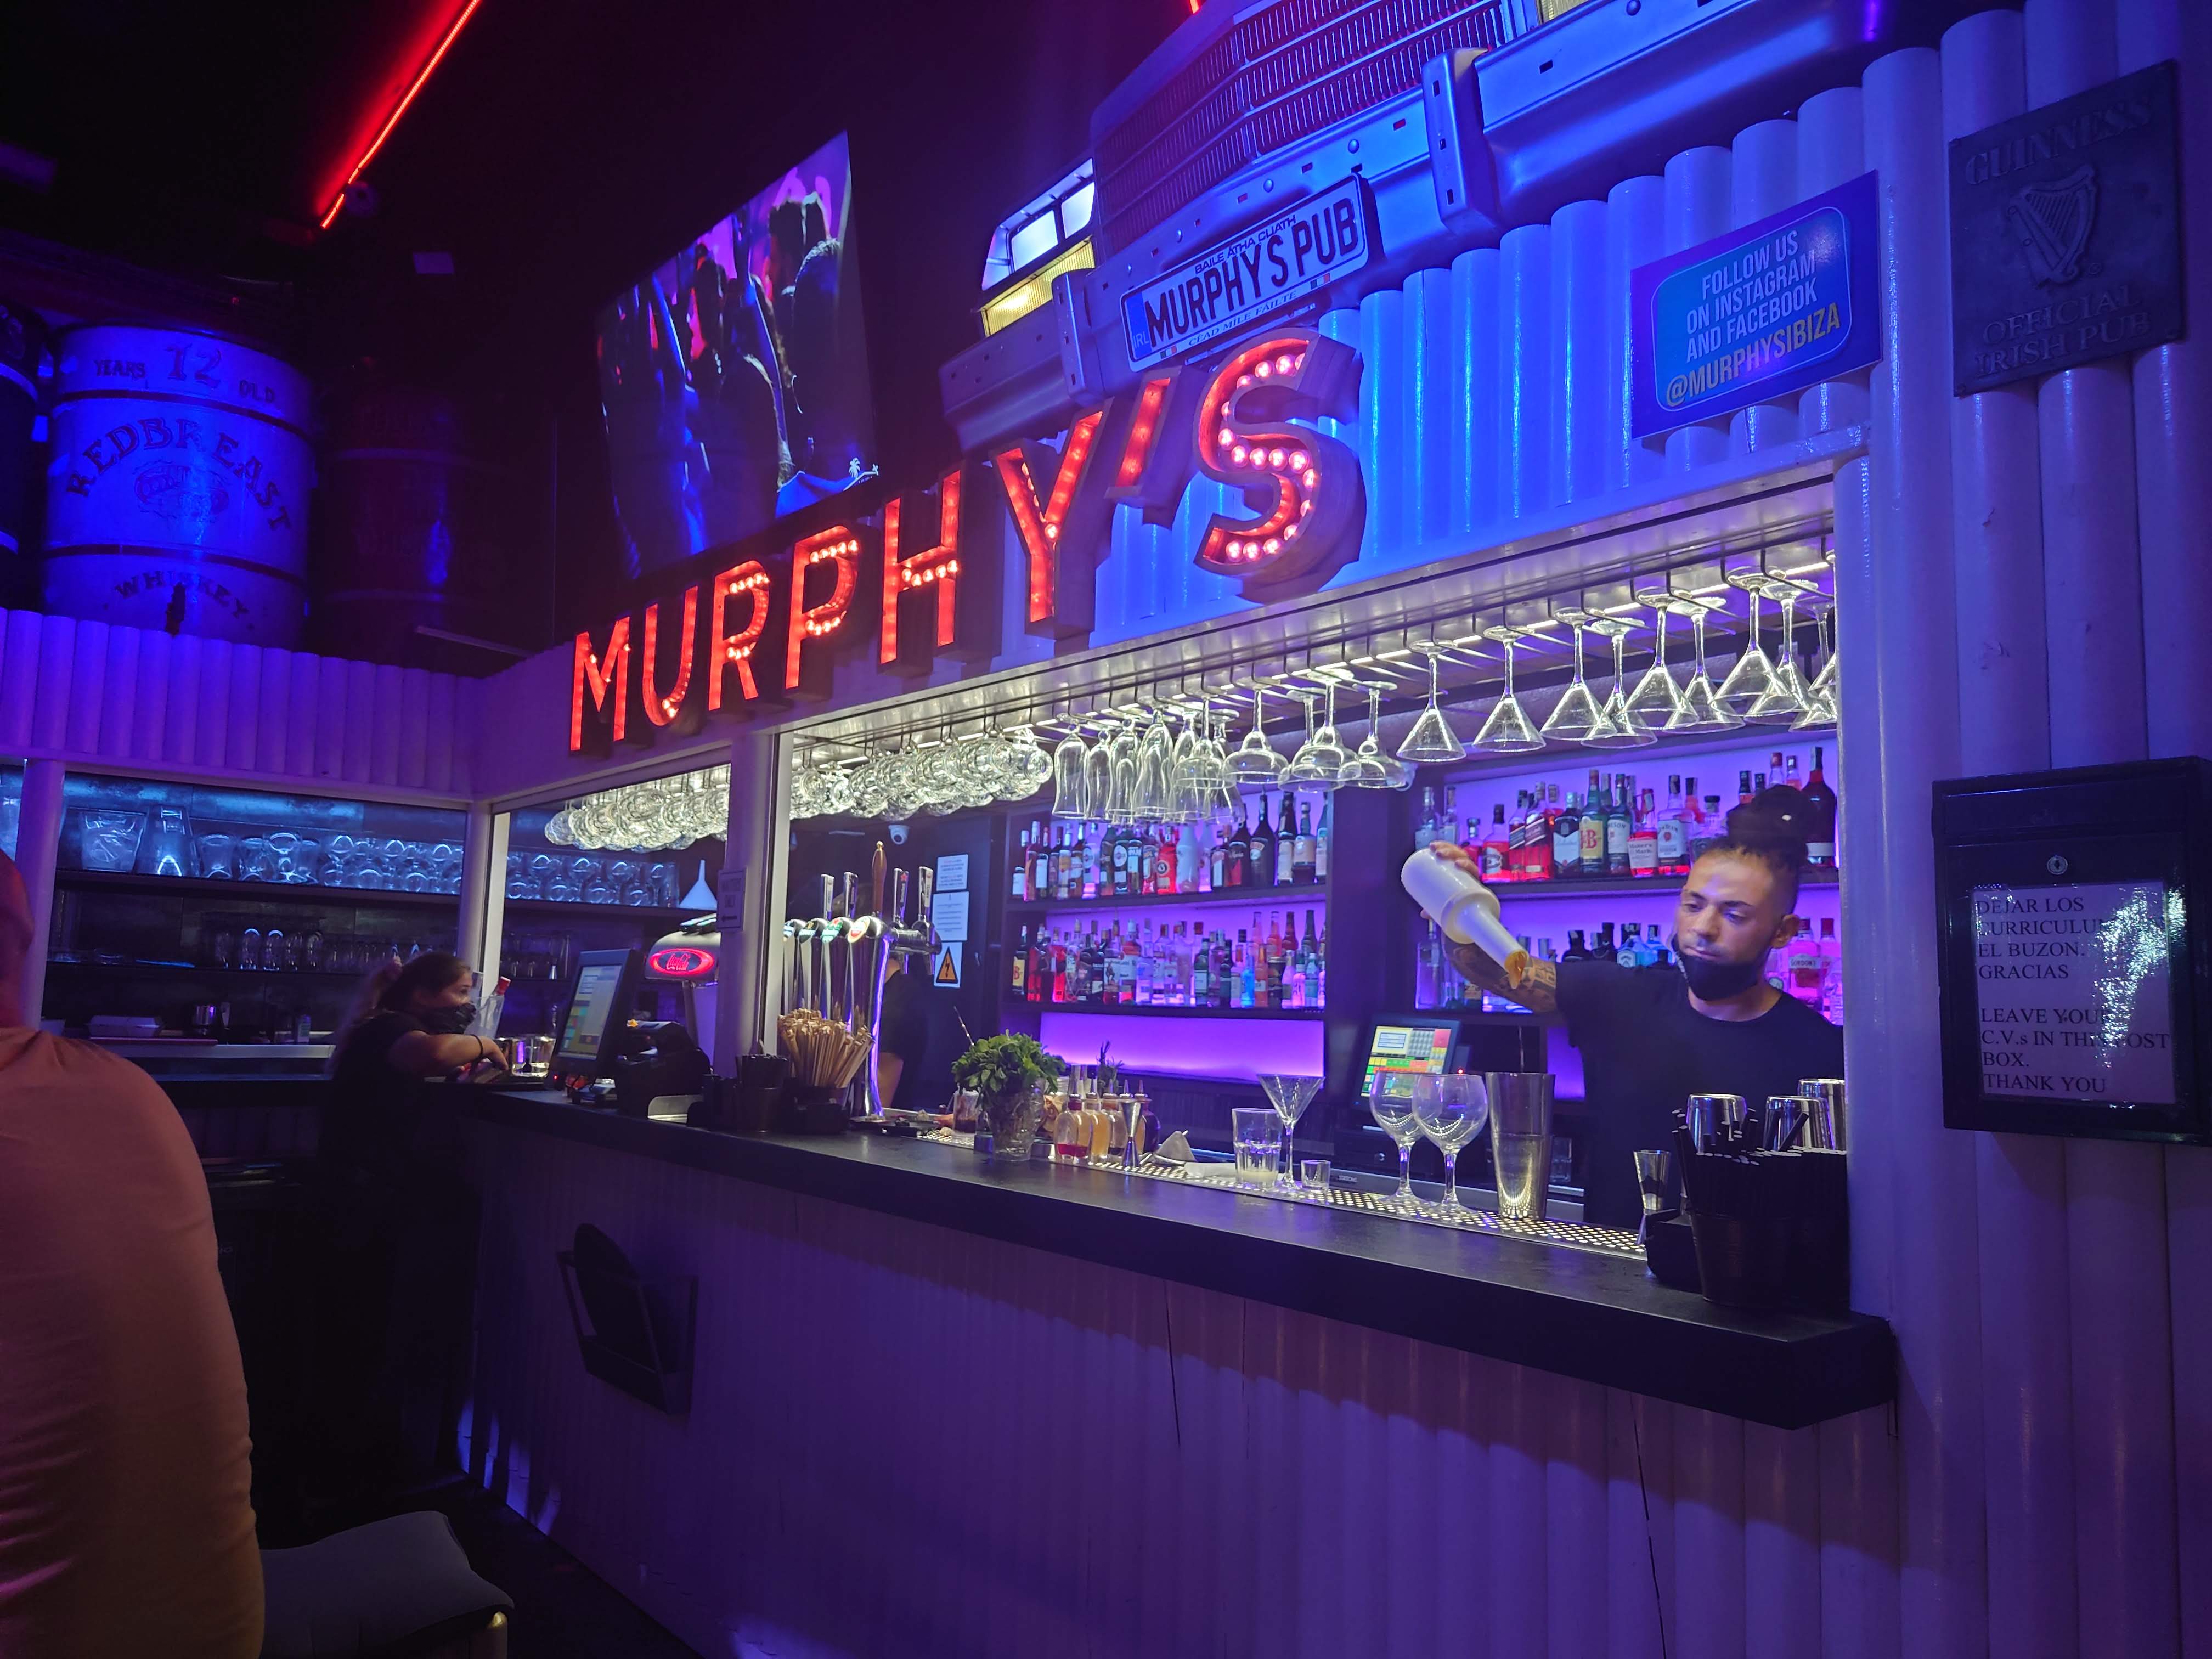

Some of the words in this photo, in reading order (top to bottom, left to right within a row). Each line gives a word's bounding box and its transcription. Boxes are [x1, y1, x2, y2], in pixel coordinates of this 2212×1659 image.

[1966, 99, 2151, 185] GUINNESS
[1145, 234, 1288, 348] MURPHYS
[1293, 198, 1358, 276] PUB
[1194, 252, 1224, 274] BAILE
[1258, 215, 1296, 242] CLIATH
[1702, 244, 1770, 300] FOLLOW
[1776, 230, 1798, 261] US
[1686, 303, 1710, 335] ON
[1715, 249, 1816, 325] INSTAGRAM
[1686, 329, 1722, 363] AND
[1726, 277, 1818, 344] FACEBOOK
[1983, 285, 2140, 346] OFFICIAL
[1133, 332, 1150, 349] IRL
[1666, 301, 1841, 407] @MURPHYSIBIZA
[1976, 332, 2069, 377] IRISH
[2078, 312, 2151, 351] PUB
[94, 359, 146, 380] YEARS
[165, 342, 224, 387] 12
[239, 379, 276, 404] OLD
[66, 416, 291, 532] REDBREAST
[569, 331, 1330, 753] MURPHY'S
[114, 569, 250, 619] WHIKEY
[1977, 898, 2039, 915] DEJAR
[2045, 896, 2084, 912] LOS
[1978, 918, 2115, 936] CURRICULU
[1978, 943, 2002, 958] EL
[2008, 941, 2085, 958] BUZON.
[1979, 963, 2069, 980] GRACIAS
[1980, 1008, 2047, 1023] LEAVE
[2053, 1008, 2114, 1025] YOU
[1981, 1030, 2028, 1045] C.V.s
[2034, 1031, 2055, 1046] IN
[2117, 1032, 2170, 1049] OST
[1982, 1051, 2030, 1068] BOX.
[1983, 1073, 2055, 1092] THANK
[2061, 1076, 2107, 1094] YOU
